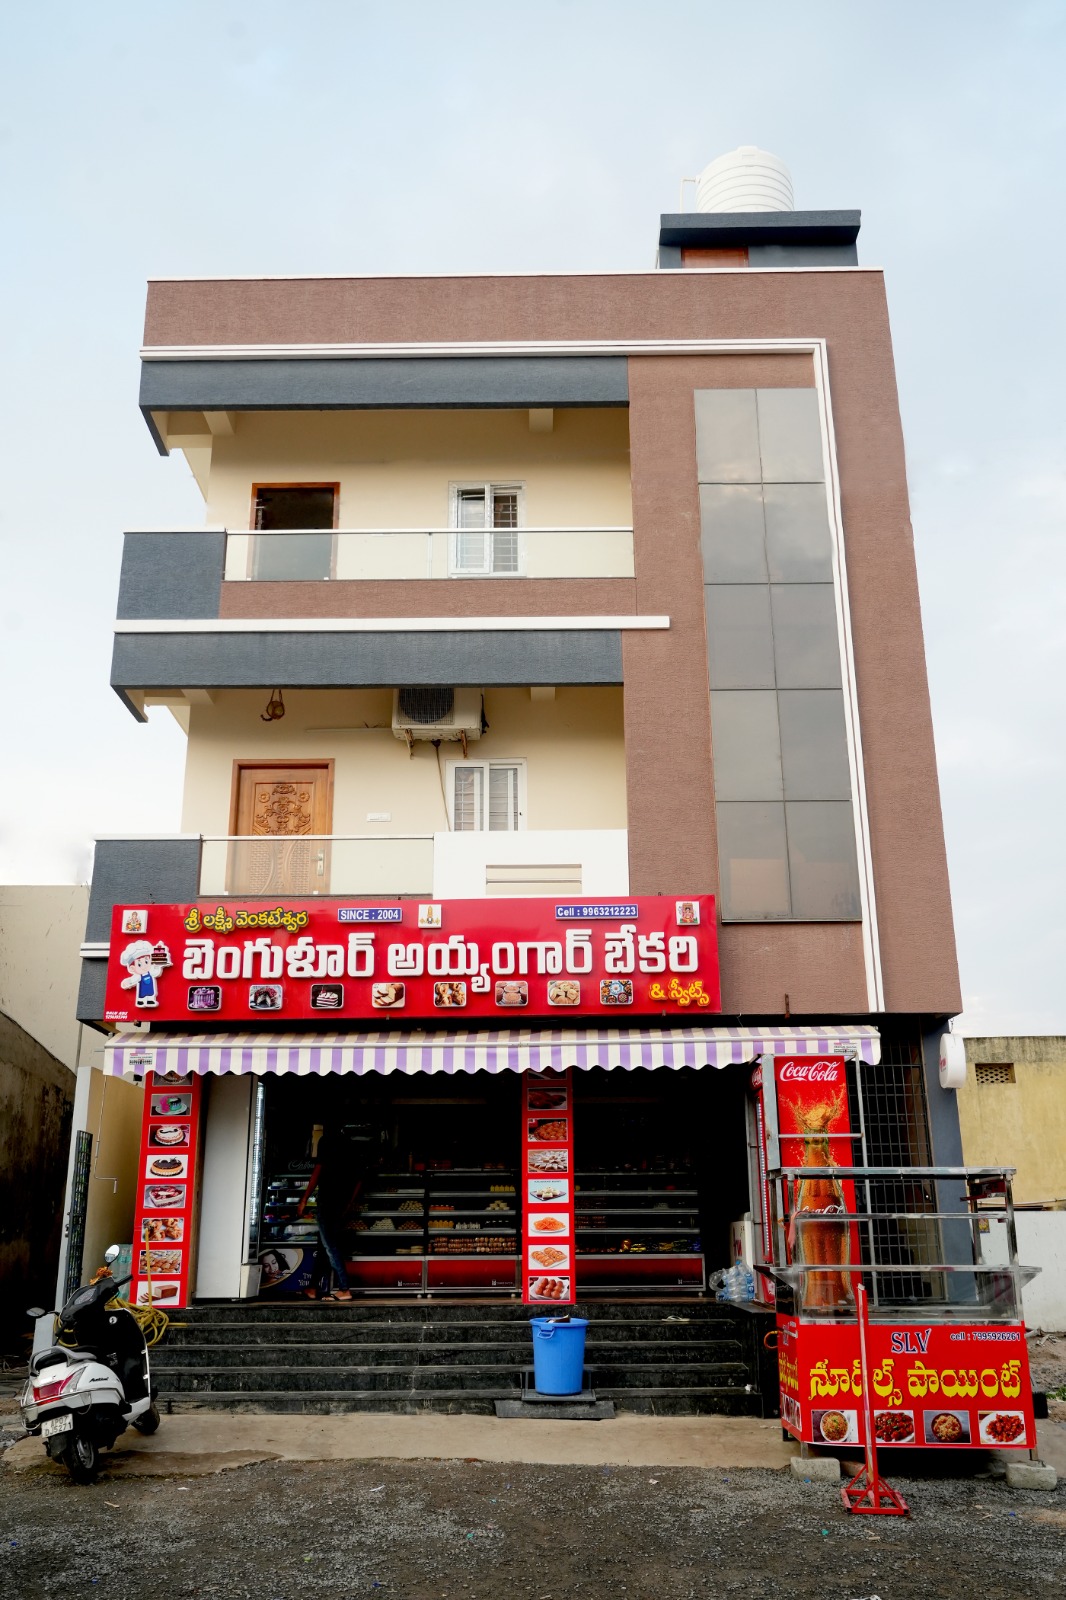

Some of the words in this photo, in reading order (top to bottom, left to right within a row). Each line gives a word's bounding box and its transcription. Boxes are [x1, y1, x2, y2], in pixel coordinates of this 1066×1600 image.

[184, 907, 203, 933] శ్రీ
[235, 907, 309, 933] వెంకటేశ్వర
[340, 910, 370, 920] SINCE
[377, 909, 399, 920] 2004
[557, 907, 575, 917] Cell
[582, 906, 637, 916] 9963212223
[182, 932, 375, 980] బెంగుళూర్
[387, 929, 593, 993] అయ్యంగార్
[650, 983, 666, 999] &
[780, 1061, 840, 1082] Coca-Cola
[891, 1328, 932, 1354] SLV
[950, 1332, 966, 1341] cell
